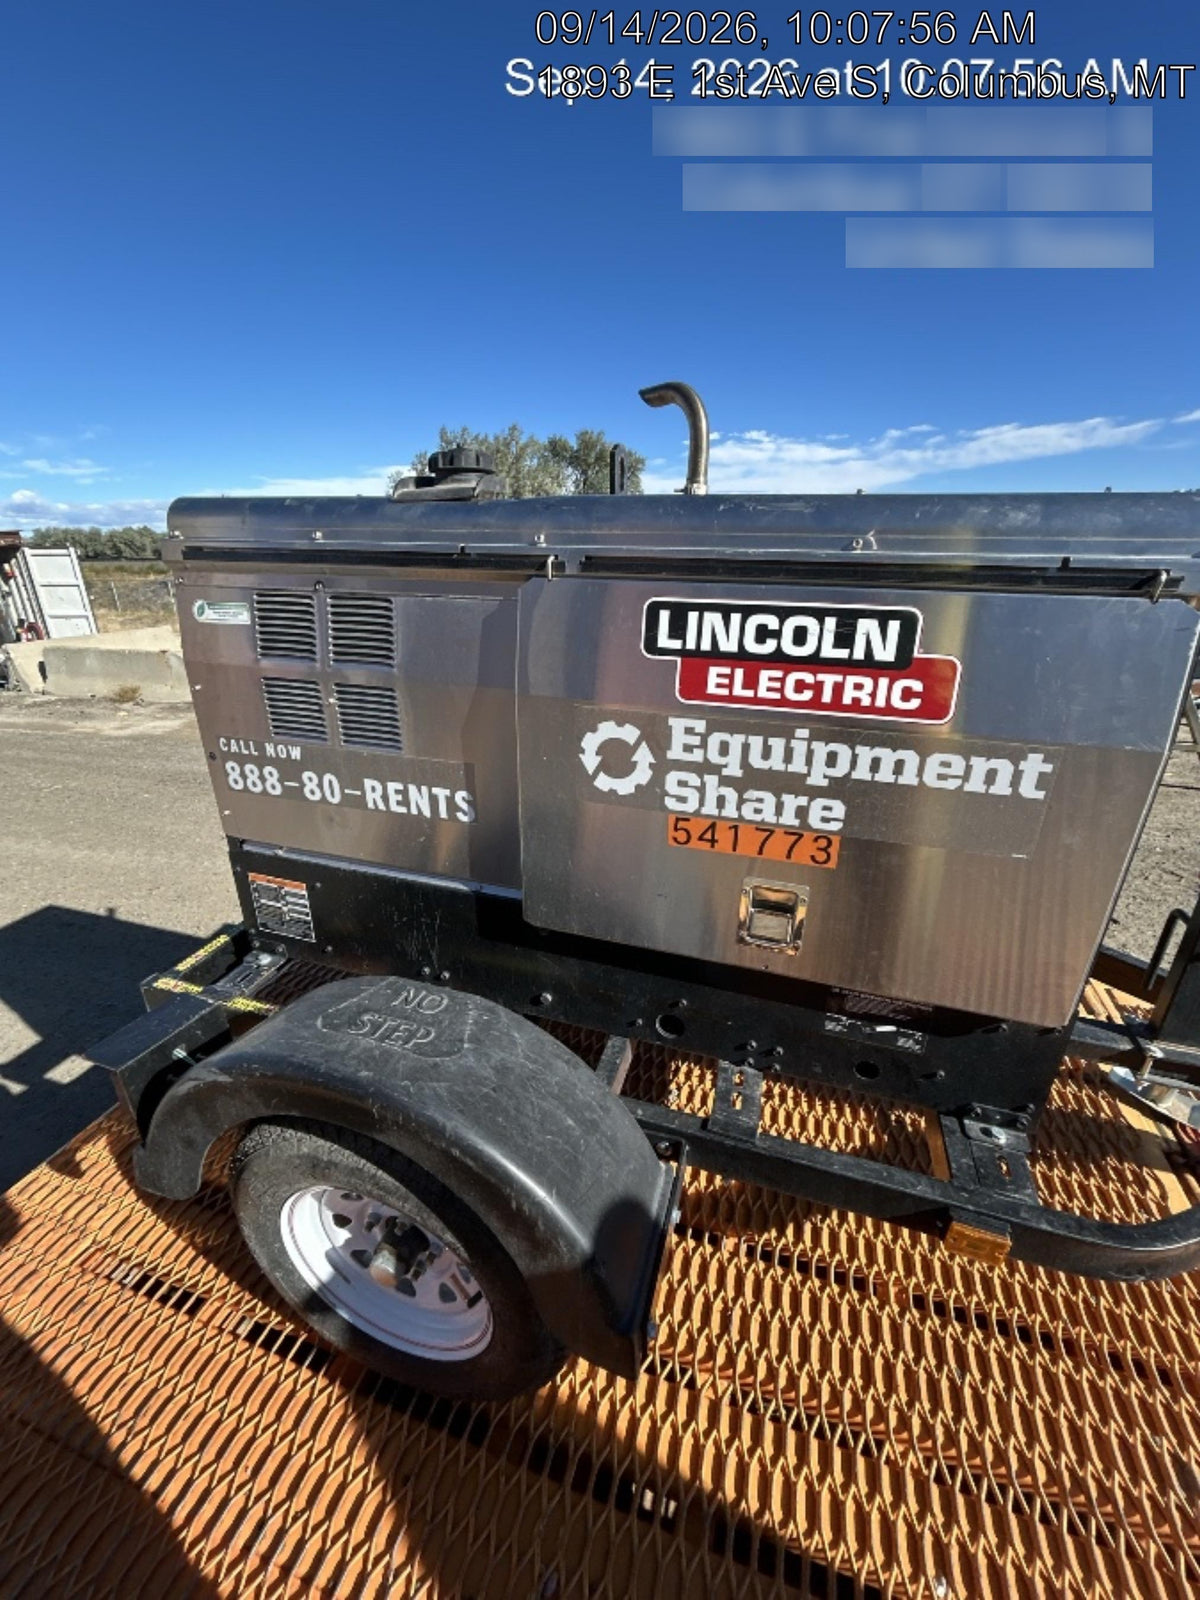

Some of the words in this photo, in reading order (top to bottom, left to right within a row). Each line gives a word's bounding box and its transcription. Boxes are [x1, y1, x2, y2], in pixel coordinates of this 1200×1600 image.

[656, 608, 902, 662] LINCOLN
[705, 666, 924, 710] ELECTRIC
[219, 737, 259, 756] CALL
[265, 742, 302, 760] NOW
[666, 716, 1054, 800] Equipment
[225, 760, 476, 823] 888-80-RENTS
[664, 770, 847, 831] Share
[672, 816, 834, 866] 541773
[391, 986, 449, 1014] NO
[348, 1012, 436, 1048] STEP
